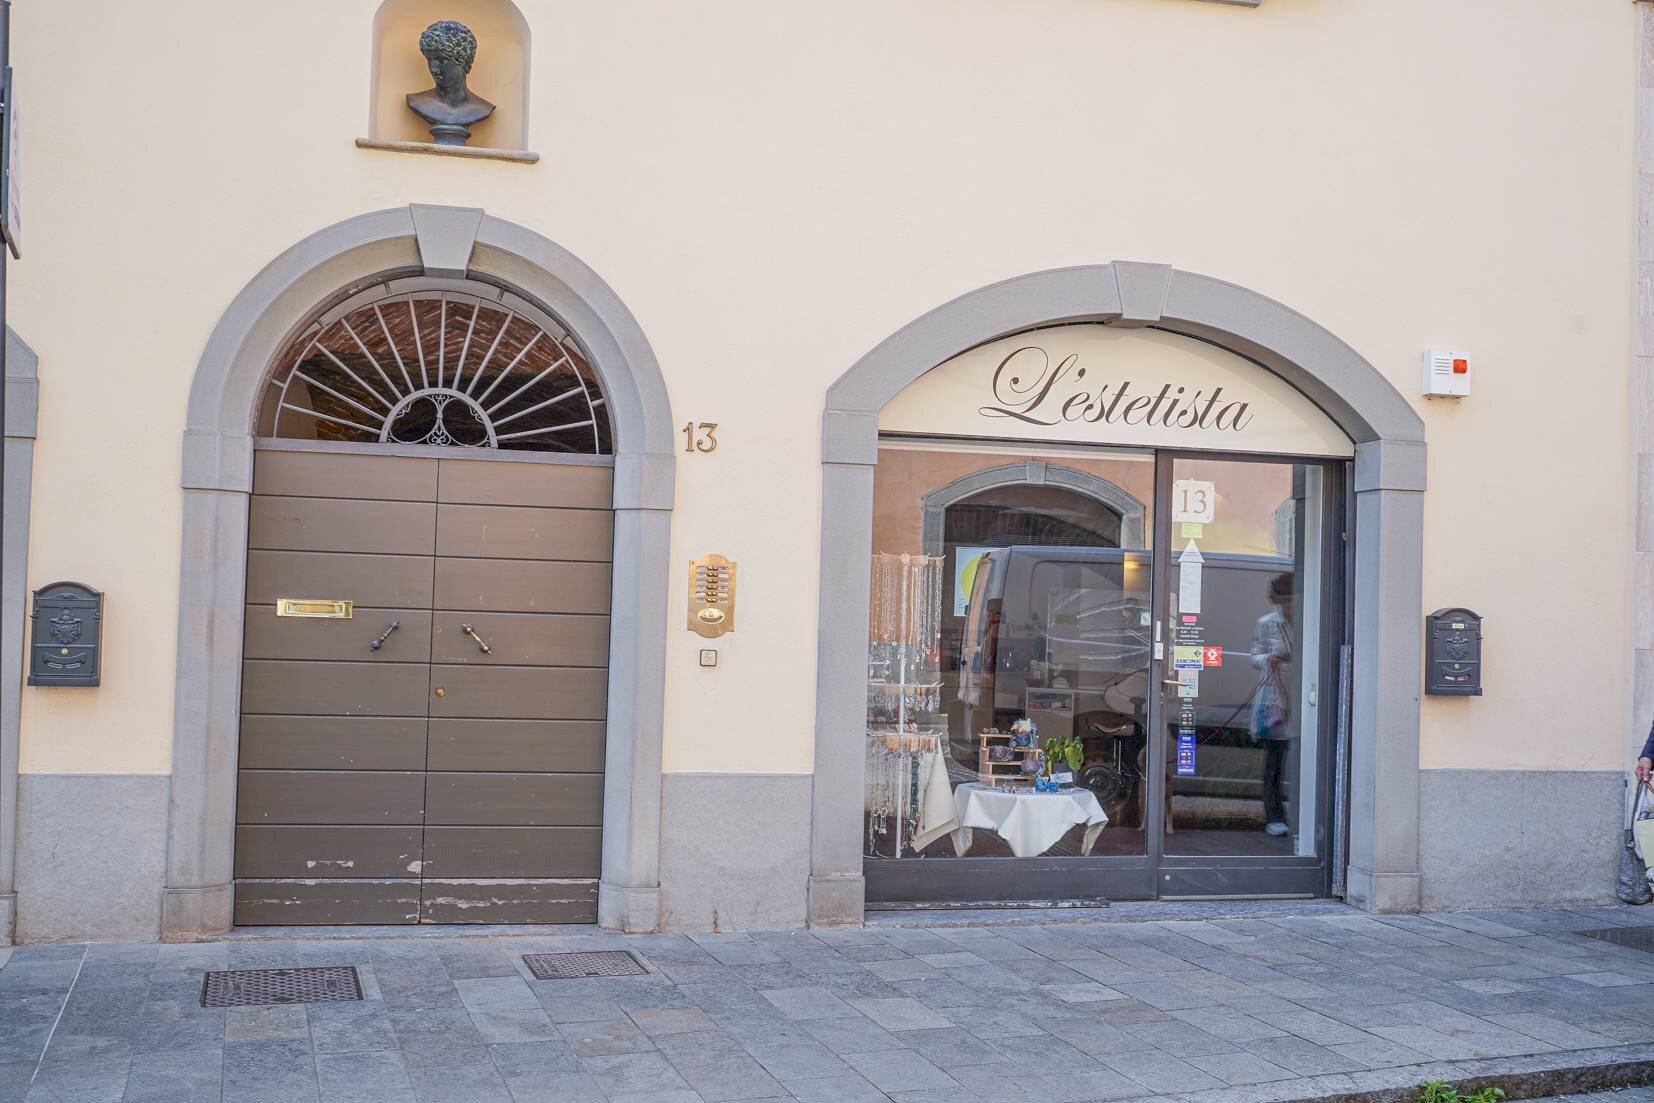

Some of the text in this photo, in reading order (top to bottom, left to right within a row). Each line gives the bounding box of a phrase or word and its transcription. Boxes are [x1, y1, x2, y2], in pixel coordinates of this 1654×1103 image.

[978, 346, 1254, 432] L'estetista
[682, 421, 718, 452] 13
[1180, 488, 1207, 514] 13
